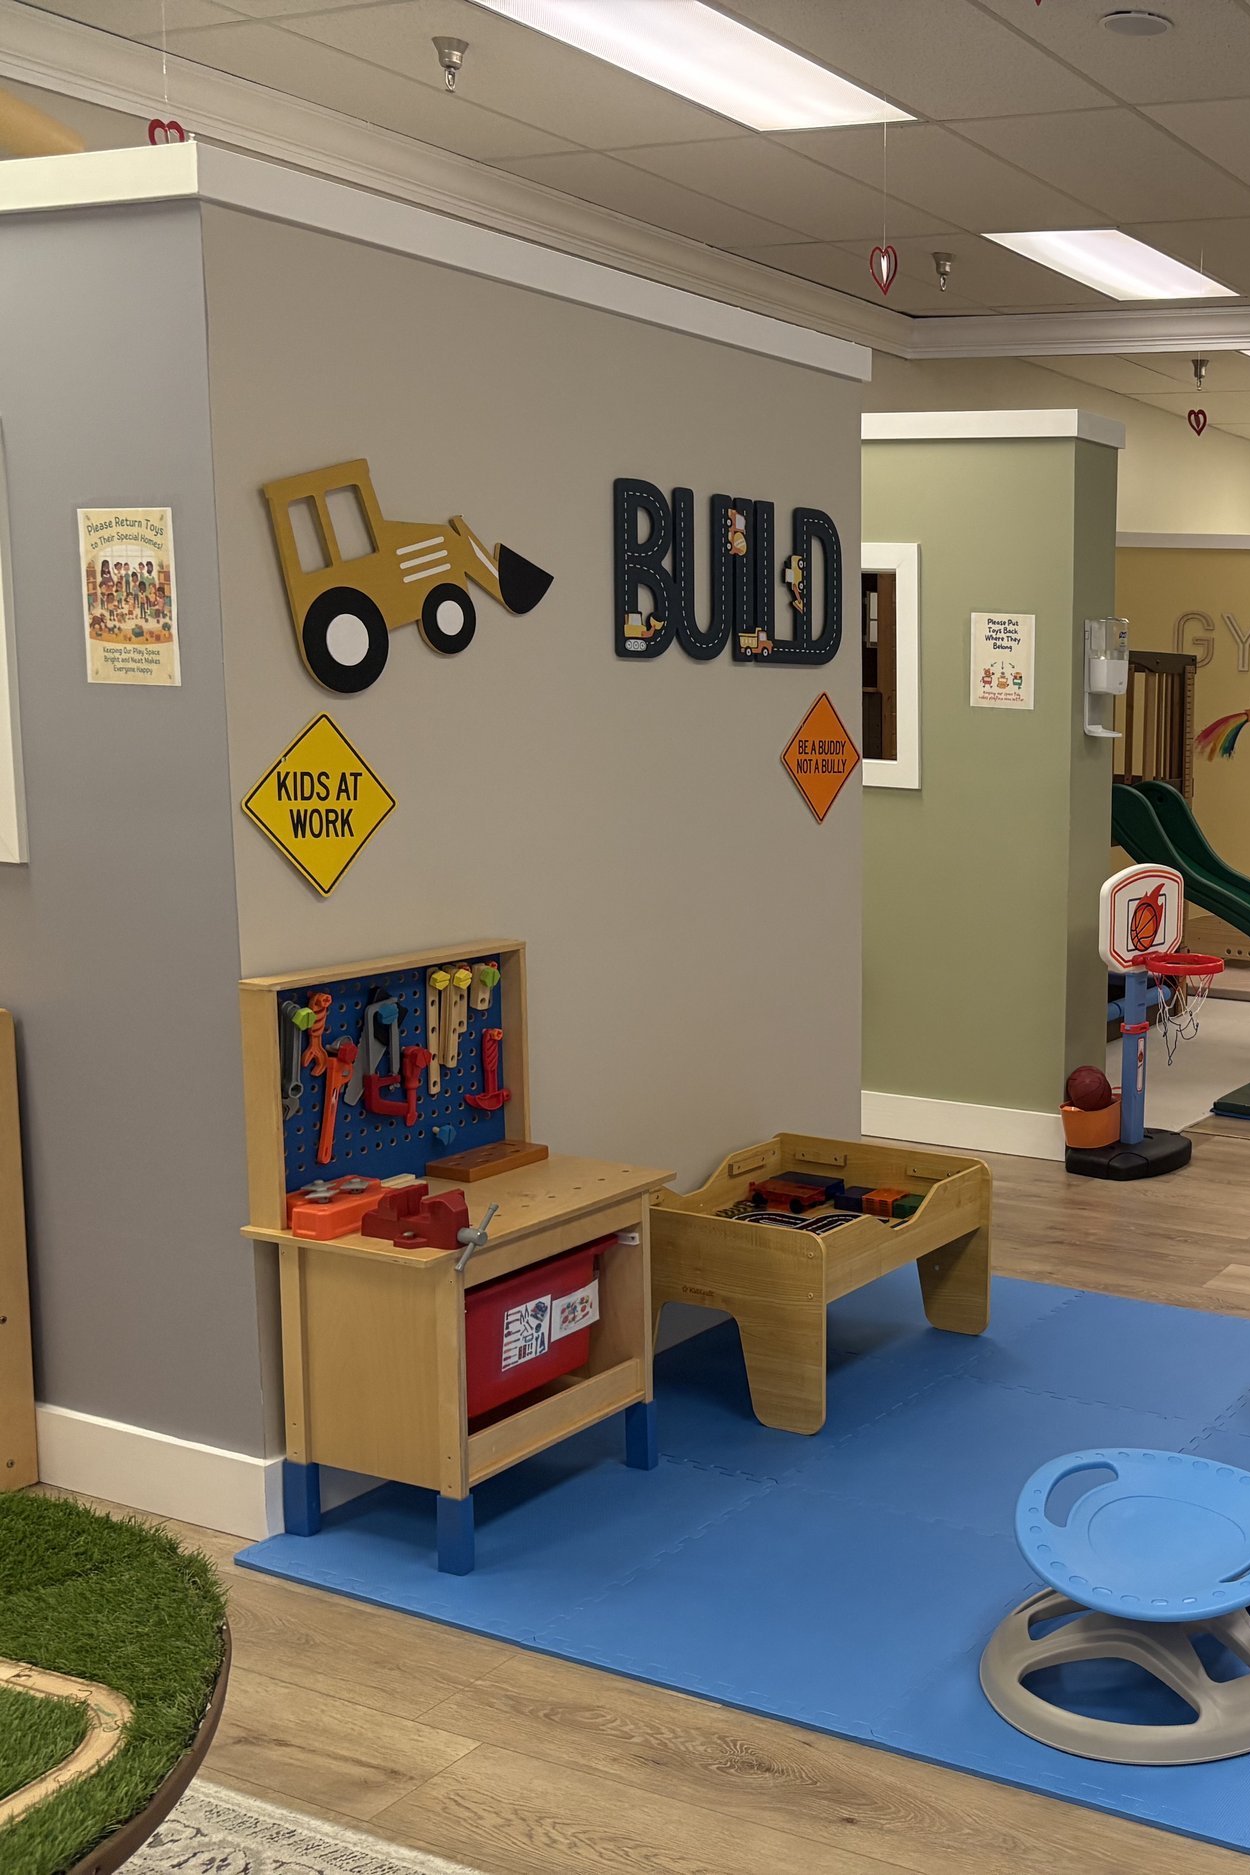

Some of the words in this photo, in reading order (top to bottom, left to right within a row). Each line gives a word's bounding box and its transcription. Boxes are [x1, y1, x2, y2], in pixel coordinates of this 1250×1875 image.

[86, 520, 113, 536] Please
[114, 516, 143, 528] Return
[144, 518, 164, 537] Toys
[90, 541, 98, 550] to
[98, 534, 115, 546] Their
[116, 531, 139, 542] Special
[613, 477, 842, 665] BUILD
[987, 618, 1007, 626] Please
[1007, 618, 1019, 627] Put
[987, 626, 1002, 636] Toys
[1002, 626, 1019, 635] Back
[984, 634, 1005, 642] Where
[1006, 635, 1021, 645] They
[992, 642, 1012, 652] Belong
[798, 739, 809, 755] BE
[810, 740, 816, 755] A
[818, 740, 847, 755] BUDDY
[796, 758, 813, 774] NOT
[814, 758, 820, 774] A
[821, 758, 847, 774] BULLY
[276, 771, 330, 801] KIDS
[336, 772, 363, 801] AT
[289, 808, 354, 839] WORK
